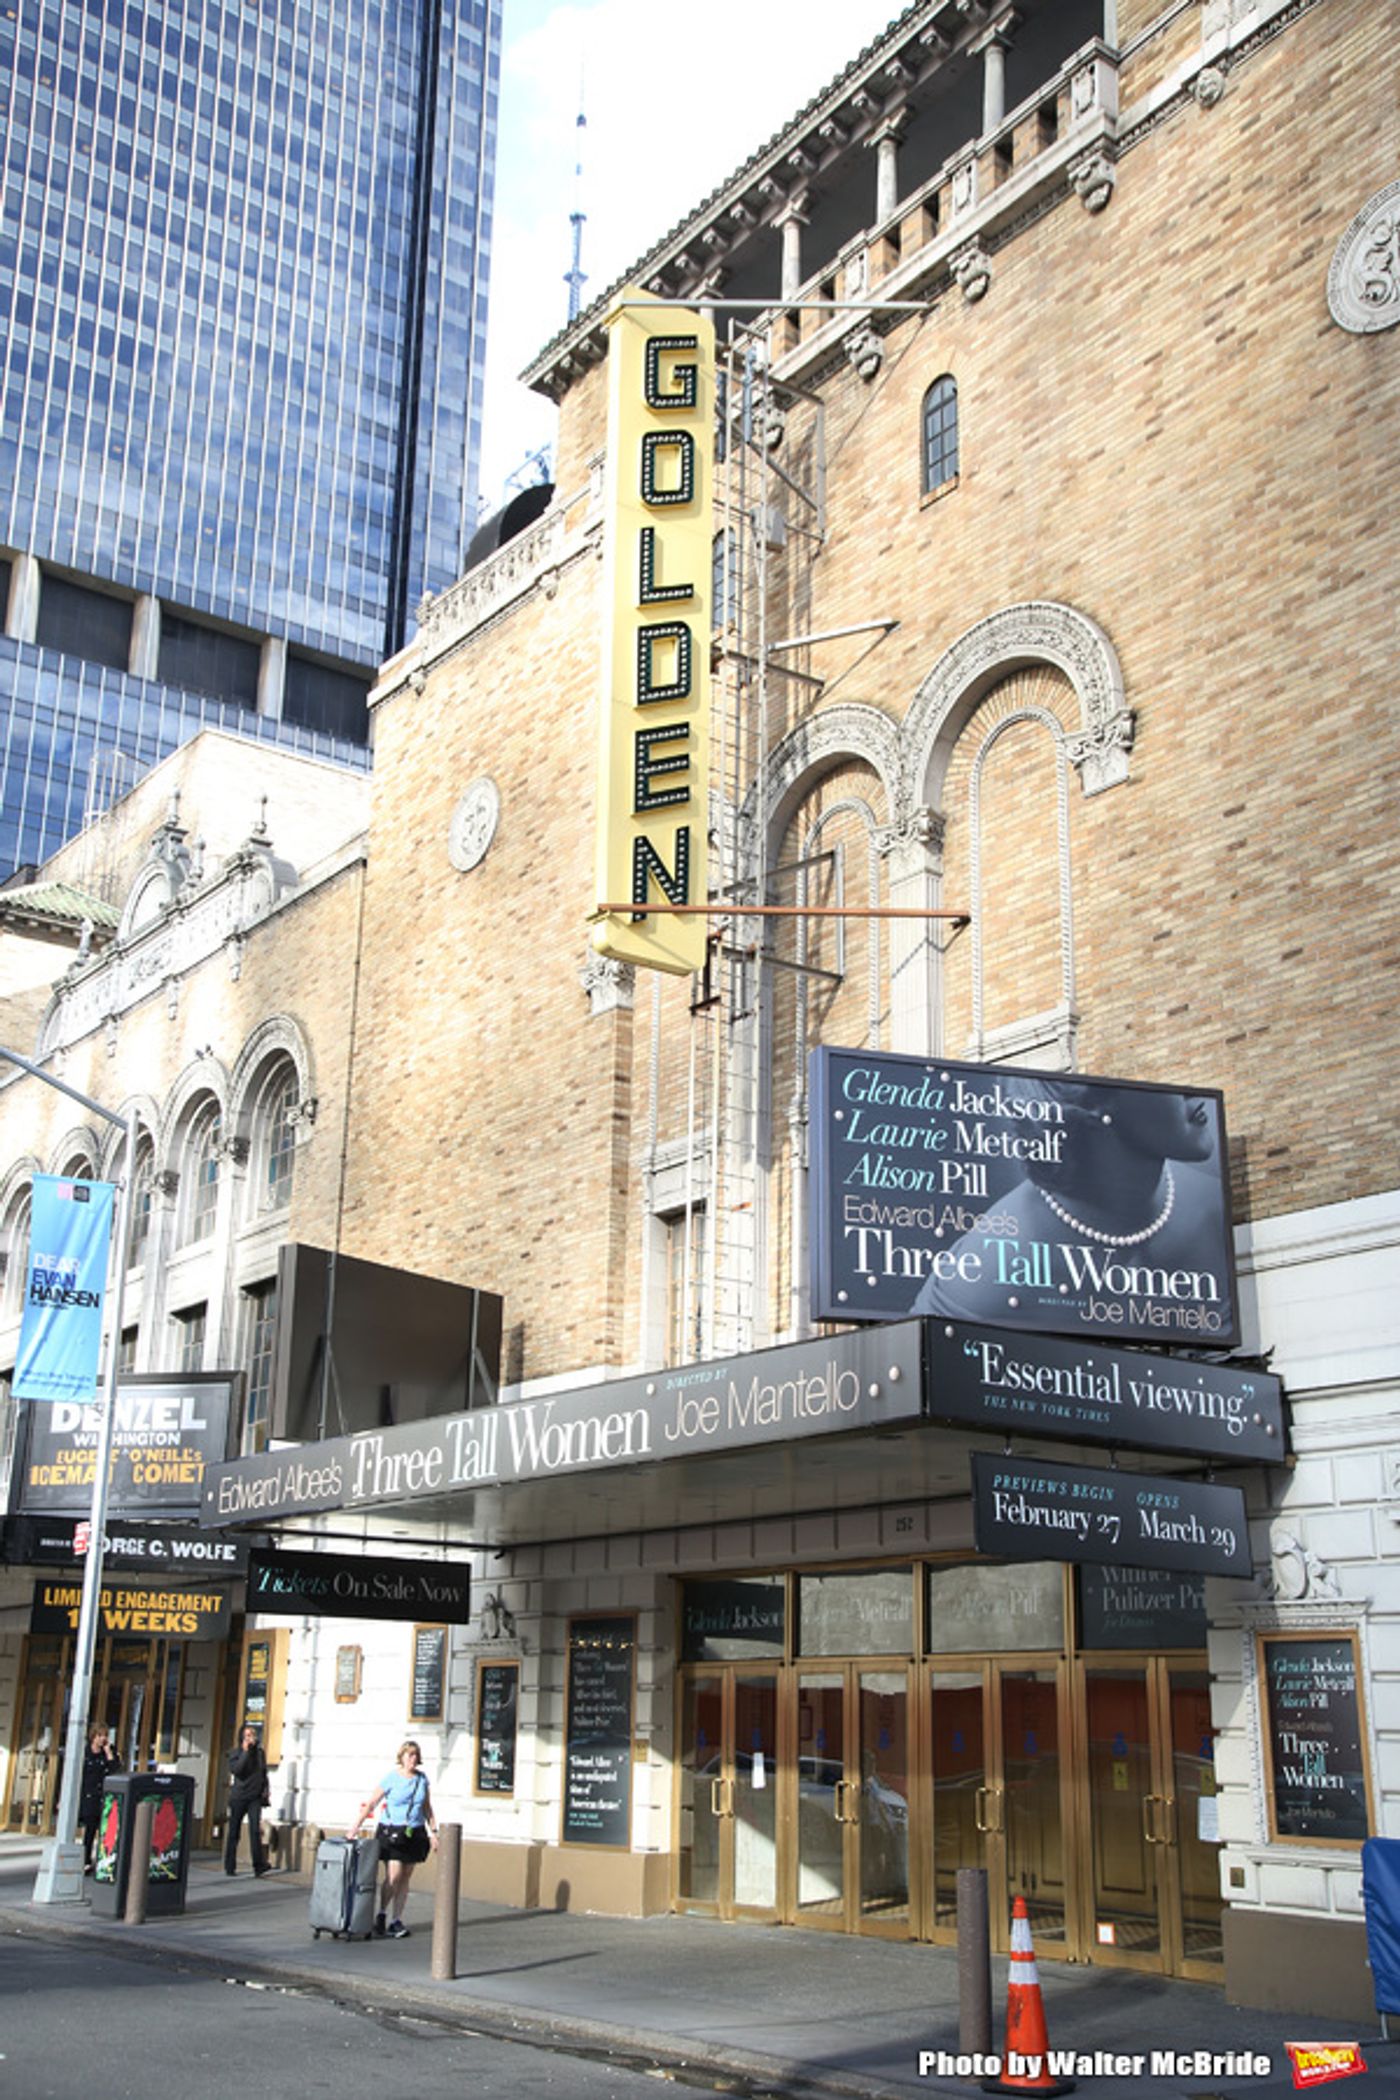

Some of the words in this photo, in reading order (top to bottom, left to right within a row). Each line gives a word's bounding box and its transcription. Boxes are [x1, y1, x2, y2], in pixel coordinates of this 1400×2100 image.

[631, 334, 698, 924] GOLDEN
[842, 1068, 945, 1111] Glenda
[949, 1080, 1065, 1125] Jackson
[844, 1108, 948, 1152] Laurie
[952, 1120, 1068, 1164] Metcalf
[844, 1153, 936, 1193] Alison
[938, 1160, 989, 1198] Pill
[844, 1195, 936, 1230] Edward
[33, 1253, 80, 1274] DEAR
[844, 1225, 983, 1284] Three
[984, 1238, 1052, 1289] Tall
[1056, 1243, 1222, 1302] Women
[32, 1268, 77, 1290] EVAN
[30, 1283, 100, 1308] HANSEN
[1080, 1296, 1124, 1325] Joe
[1128, 1300, 1222, 1331] Mantello
[1041, 1402, 1072, 1419] YORK
[1076, 1405, 1110, 1423] TIMES
[219, 1467, 282, 1514] Edward
[350, 1436, 443, 1499] Three
[446, 1413, 498, 1484] Tall
[506, 1401, 653, 1474] Women
[665, 1389, 720, 1441] Joe
[727, 1360, 860, 1430] Mantello
[56, 1448, 120, 1465] EUGEE
[993, 1474, 1067, 1497] PREVIEWS
[1072, 1482, 1115, 1501] BEGIN
[1136, 1491, 1180, 1510] OPENS
[993, 1491, 1091, 1541] February
[1097, 1514, 1121, 1544] 27
[1139, 1509, 1206, 1544] March
[1211, 1527, 1236, 1557] 29
[171, 1541, 237, 1561] WOLFE
[256, 1566, 329, 1595] Tickets
[333, 1571, 368, 1597] On
[373, 1572, 415, 1600] Sale
[418, 1576, 463, 1602] Now
[116, 1591, 223, 1613] ENGAGEMENT
[1102, 1586, 1175, 1613] Pulitzer
[102, 1610, 198, 1633] WEEKS
[1311, 1656, 1355, 1673] Jackson
[1279, 1731, 1329, 1754] Three
[1282, 1765, 1344, 1789] Women
